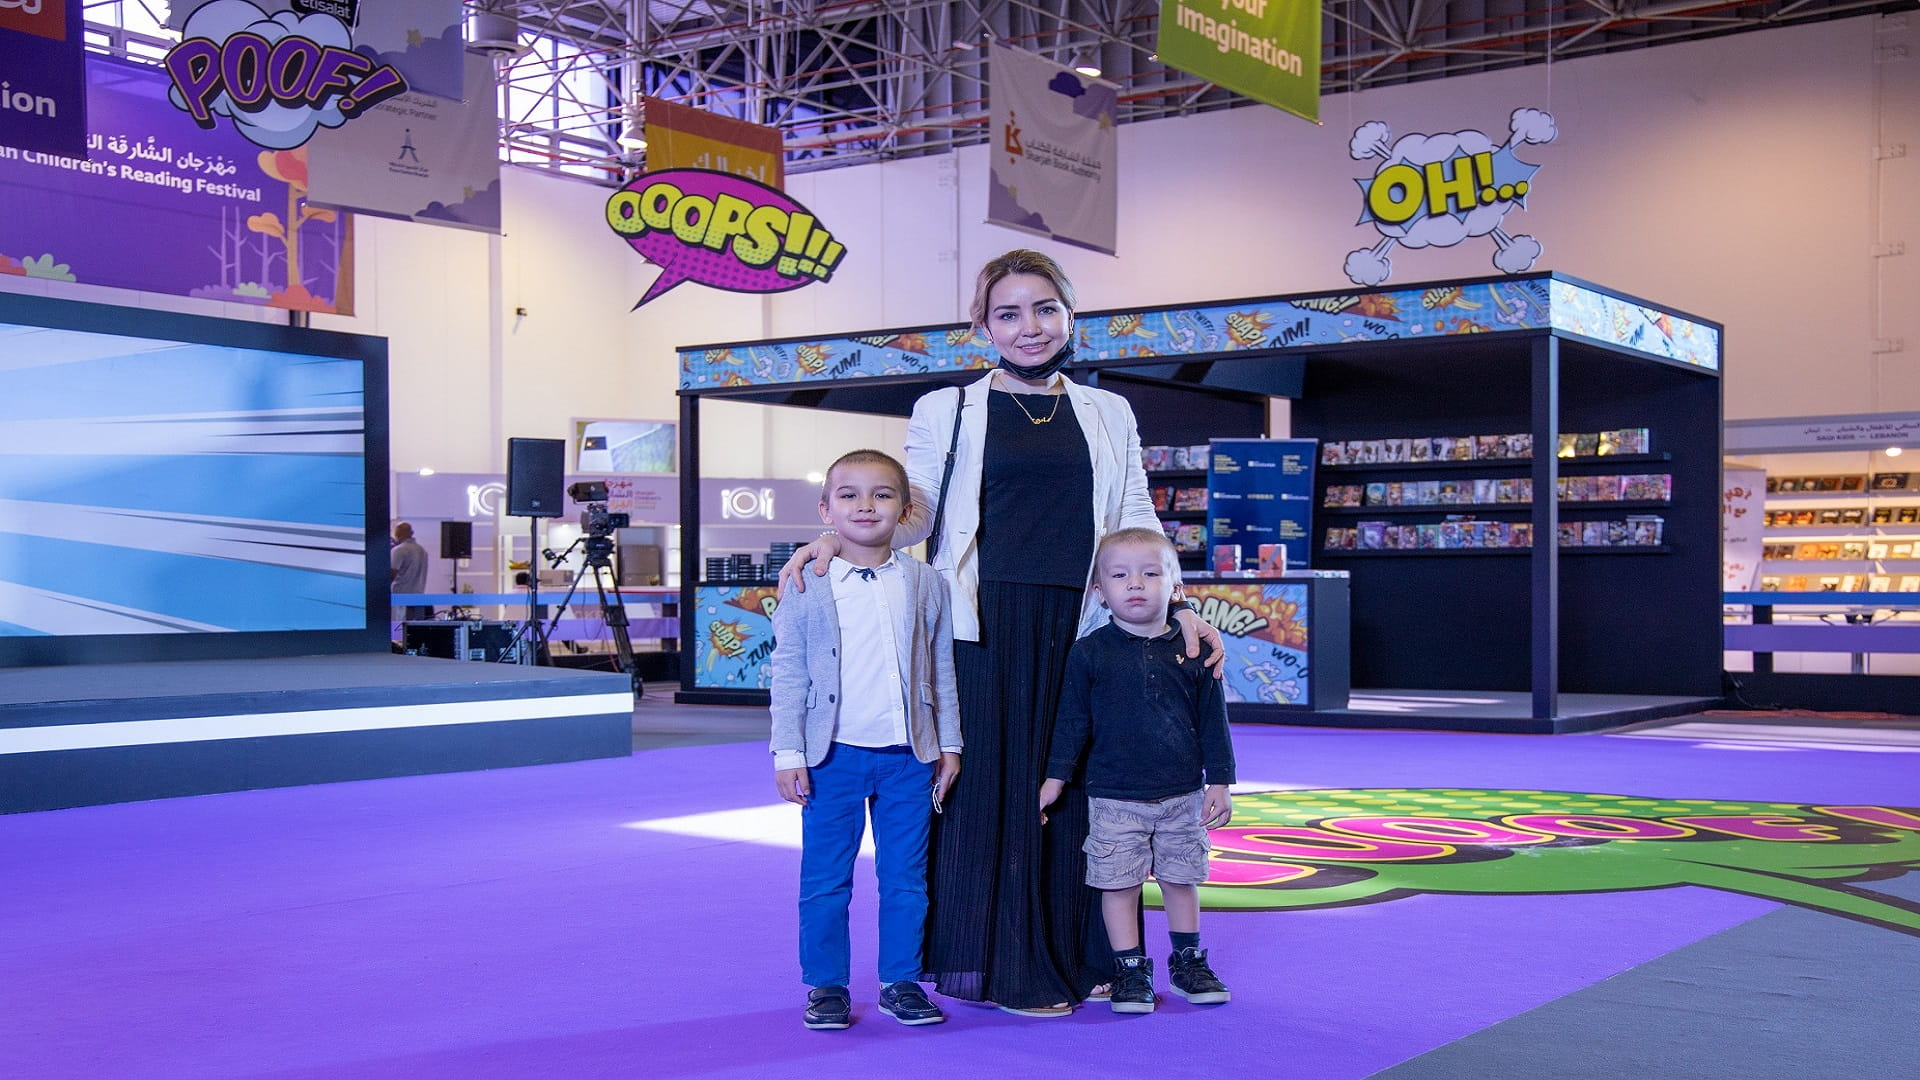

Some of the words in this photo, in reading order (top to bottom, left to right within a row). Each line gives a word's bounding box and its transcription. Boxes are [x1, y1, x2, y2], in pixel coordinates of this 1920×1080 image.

[163, 31, 408, 130] POOF!
[1177, 0, 1303, 77] imagination
[120, 164, 193, 193] Reading
[196, 178, 261, 202] Festival
[606, 182, 848, 284] OOOPS!!!
